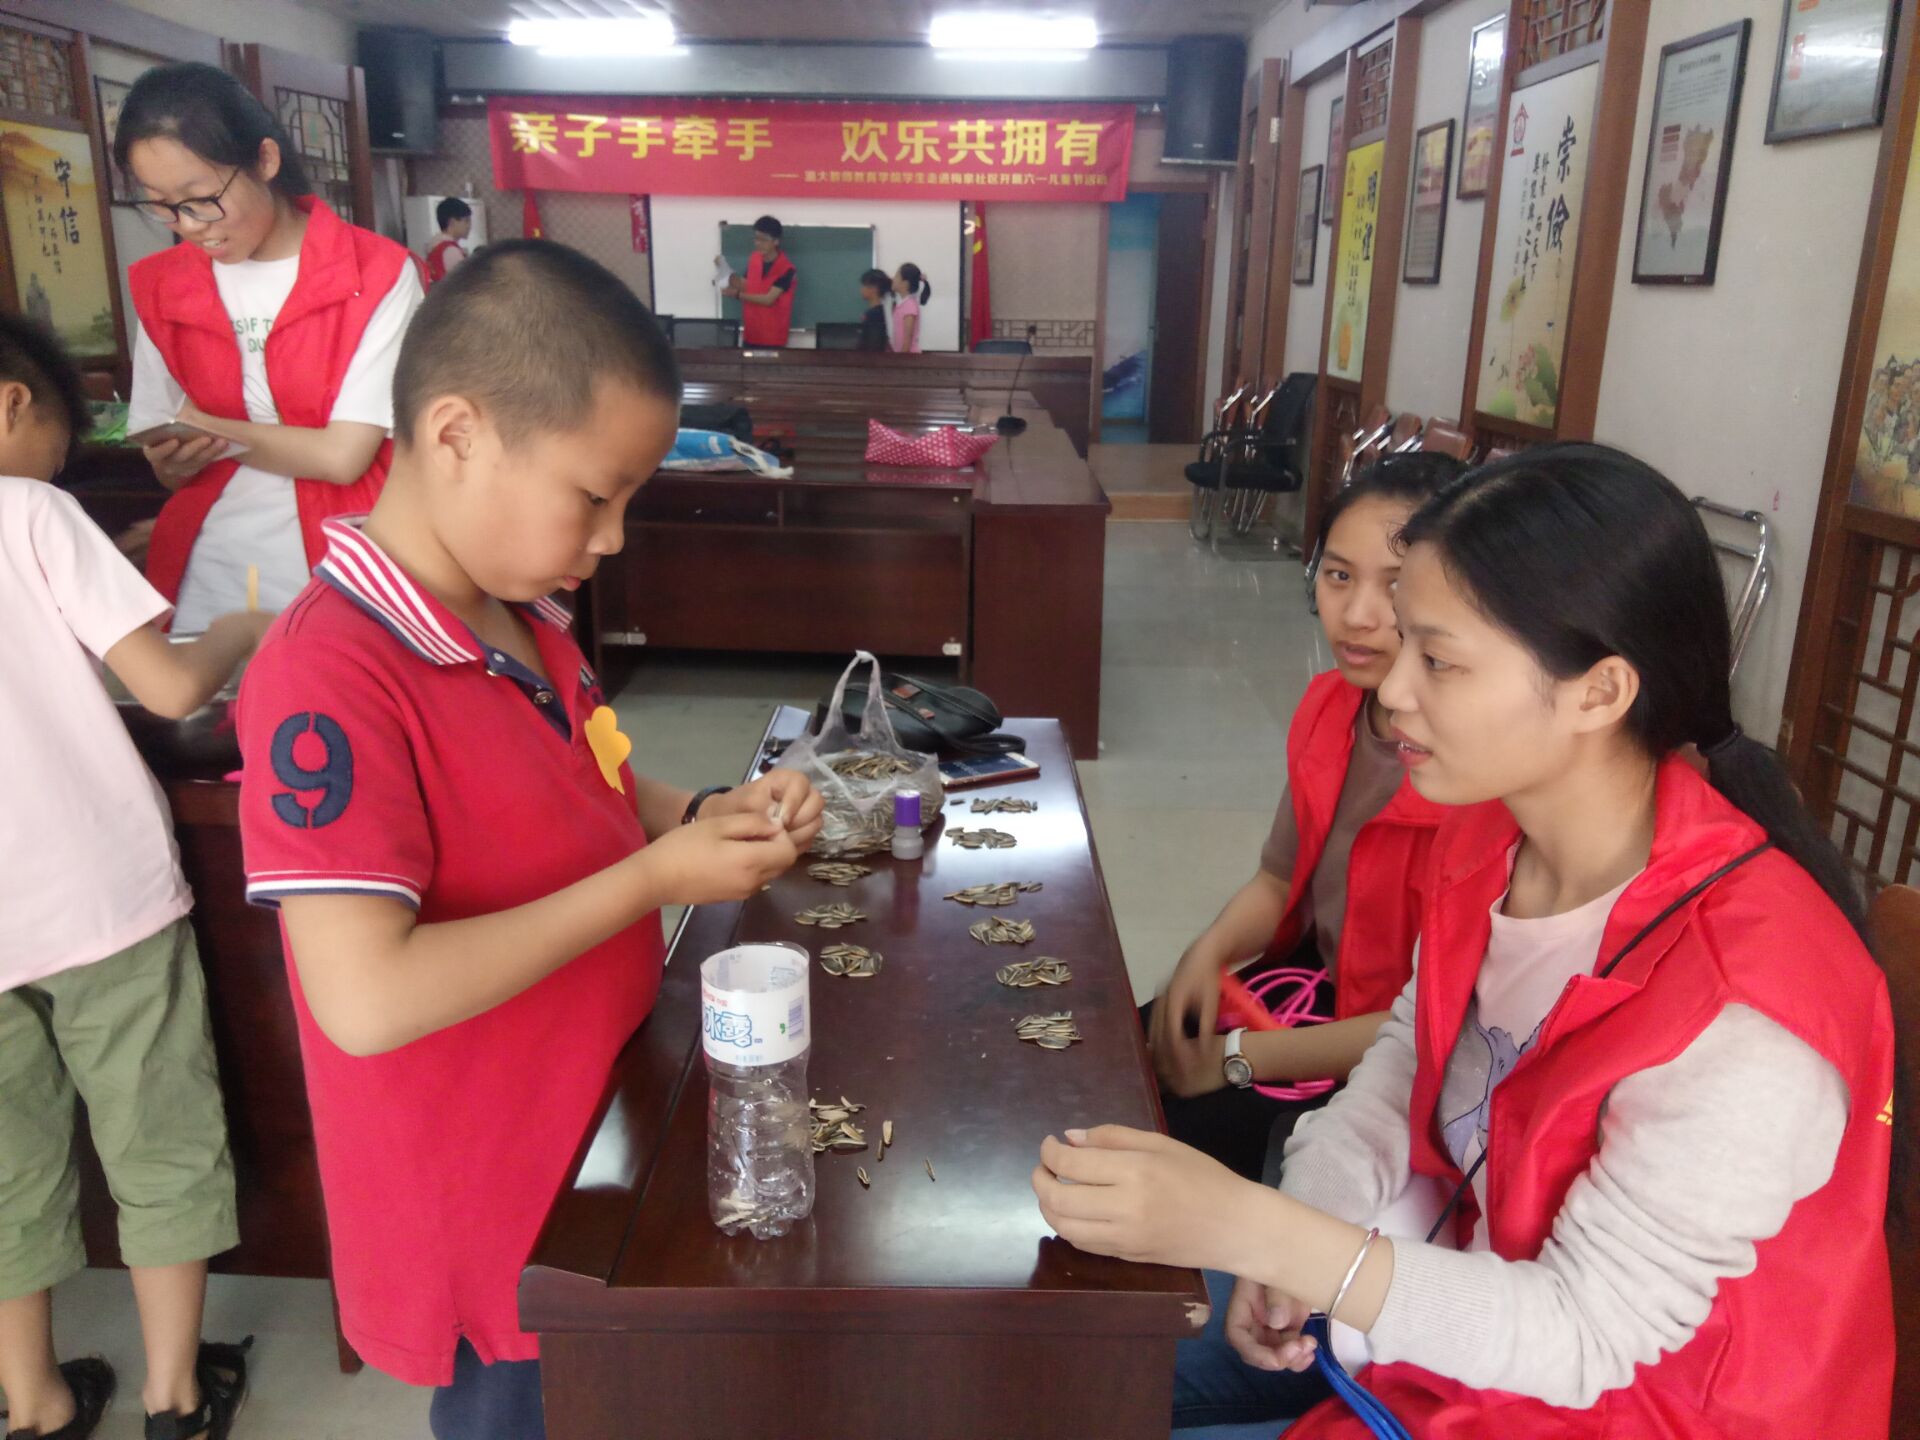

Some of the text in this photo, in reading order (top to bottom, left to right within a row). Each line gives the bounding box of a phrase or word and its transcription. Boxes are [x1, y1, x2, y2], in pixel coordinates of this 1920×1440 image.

[509, 112, 1103, 166] 亲子手牵手 欢乐共拥有
[270, 711, 354, 829] 9
